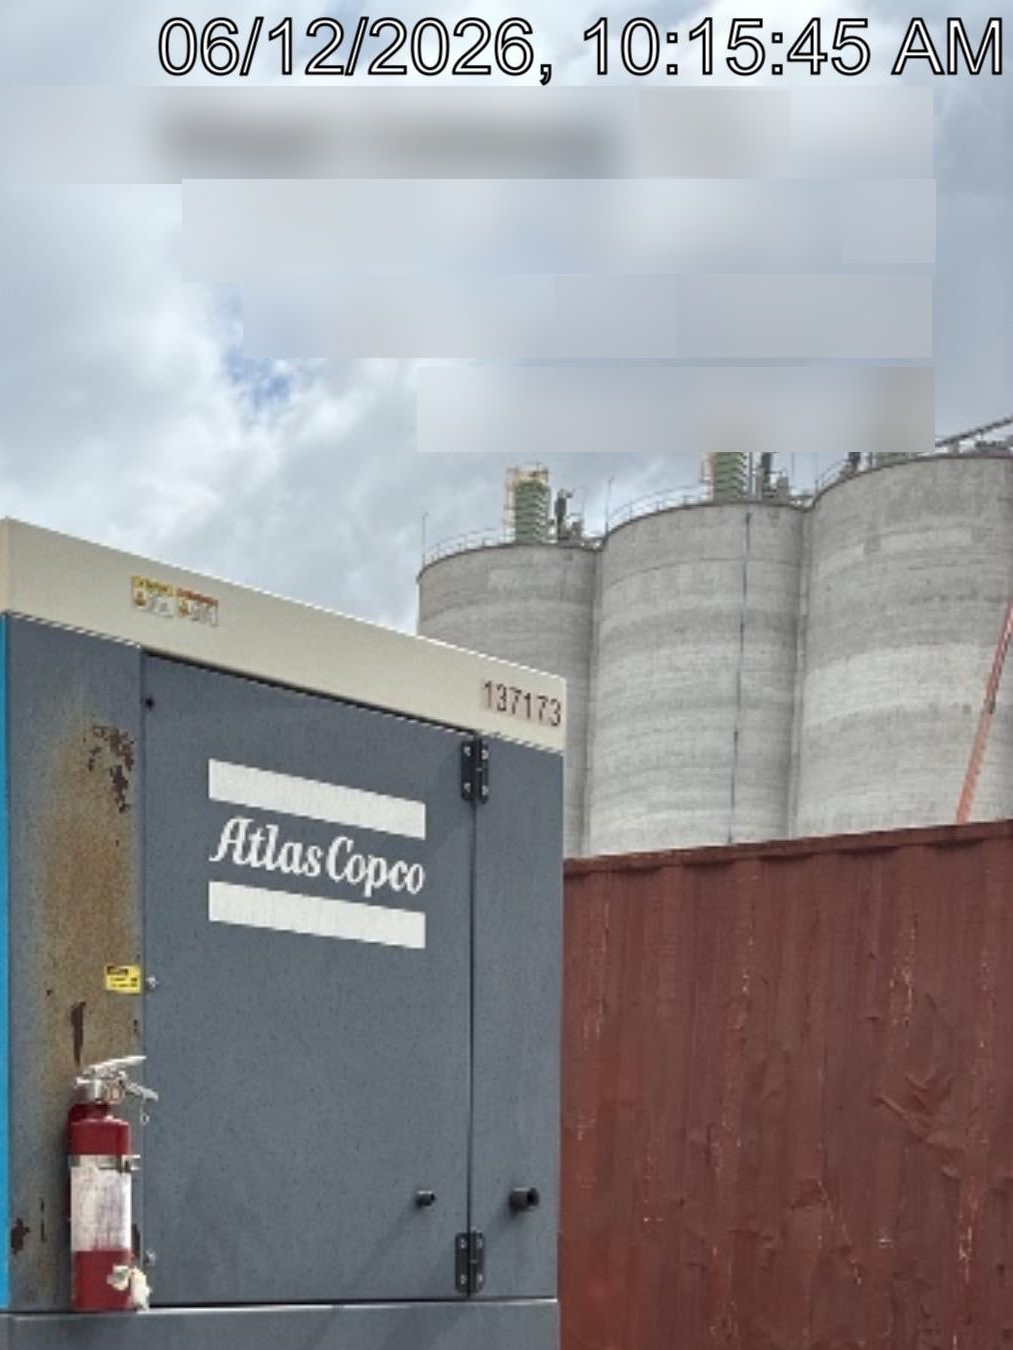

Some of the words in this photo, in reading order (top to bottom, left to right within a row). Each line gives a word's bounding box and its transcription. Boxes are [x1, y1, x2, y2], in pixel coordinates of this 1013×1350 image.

[483, 680, 561, 727] 137173
[209, 816, 323, 877] Atlas
[326, 836, 425, 897] Copco
